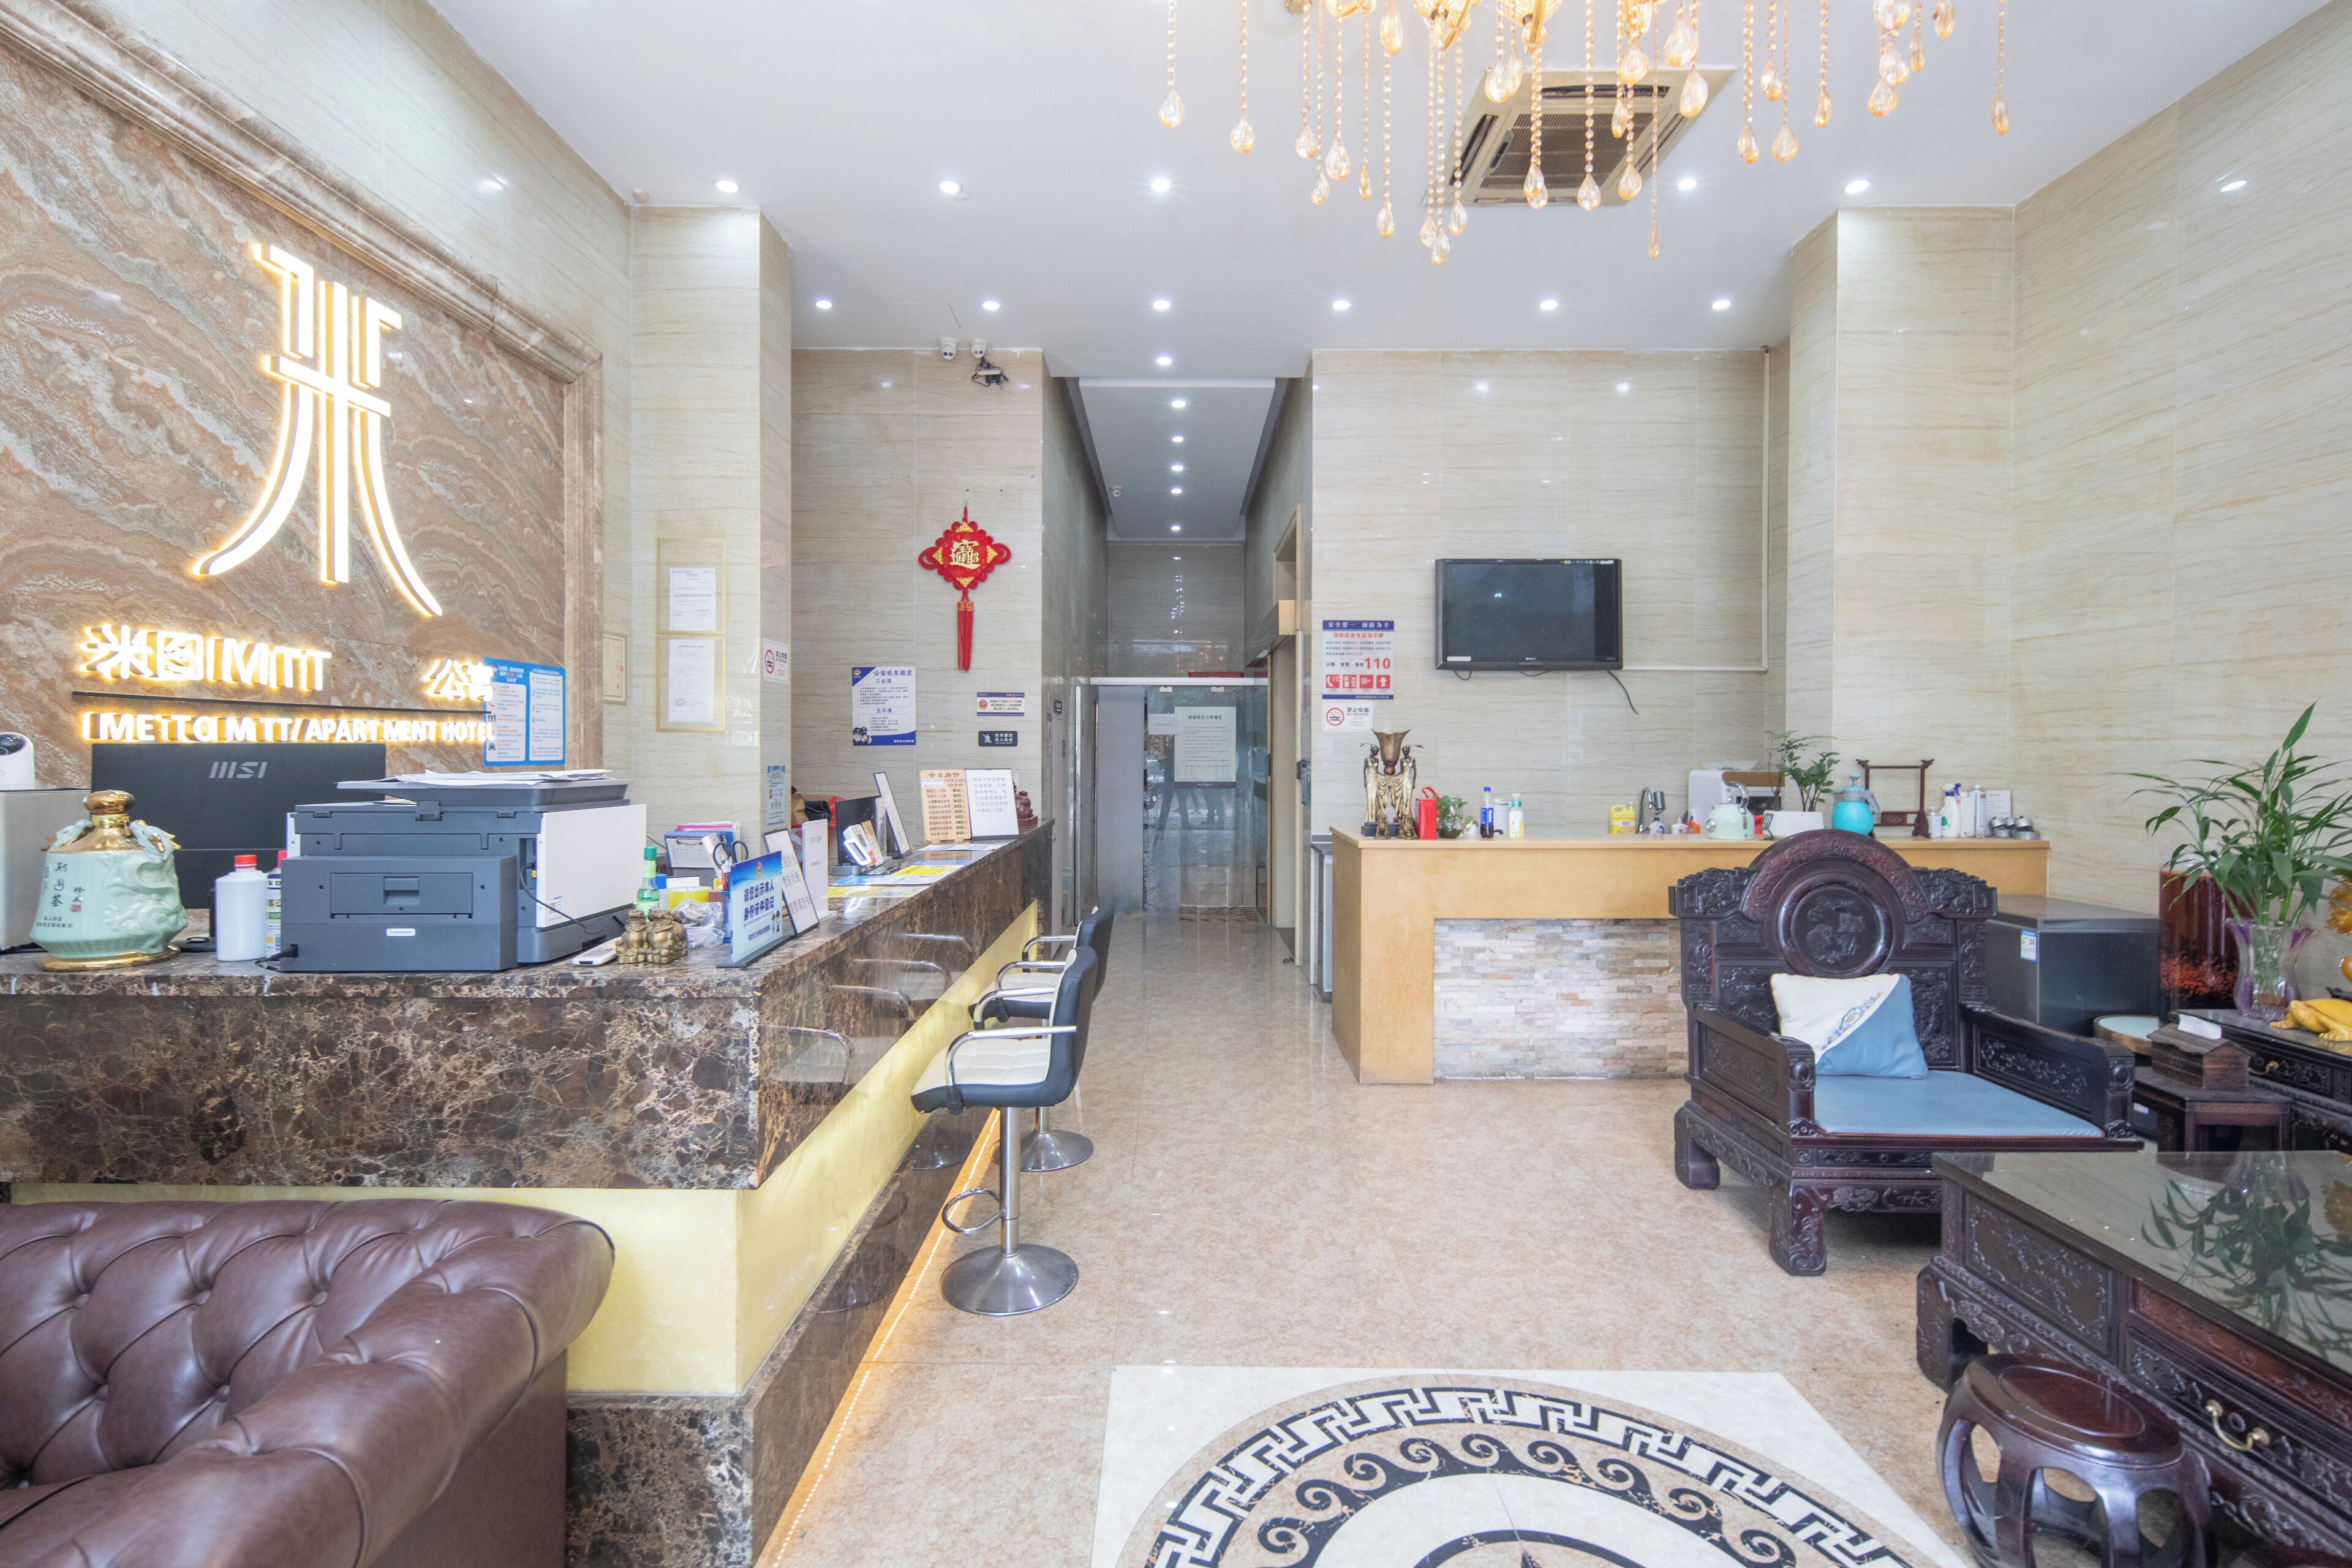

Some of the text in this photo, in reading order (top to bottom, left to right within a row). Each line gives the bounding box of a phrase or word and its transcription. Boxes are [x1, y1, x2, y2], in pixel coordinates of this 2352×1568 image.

[81, 625, 204, 680] 米图
[1365, 658, 1391, 669] 110
[441, 721, 496, 741] HOTEL
[744, 879, 774, 902] 请您出示本人
